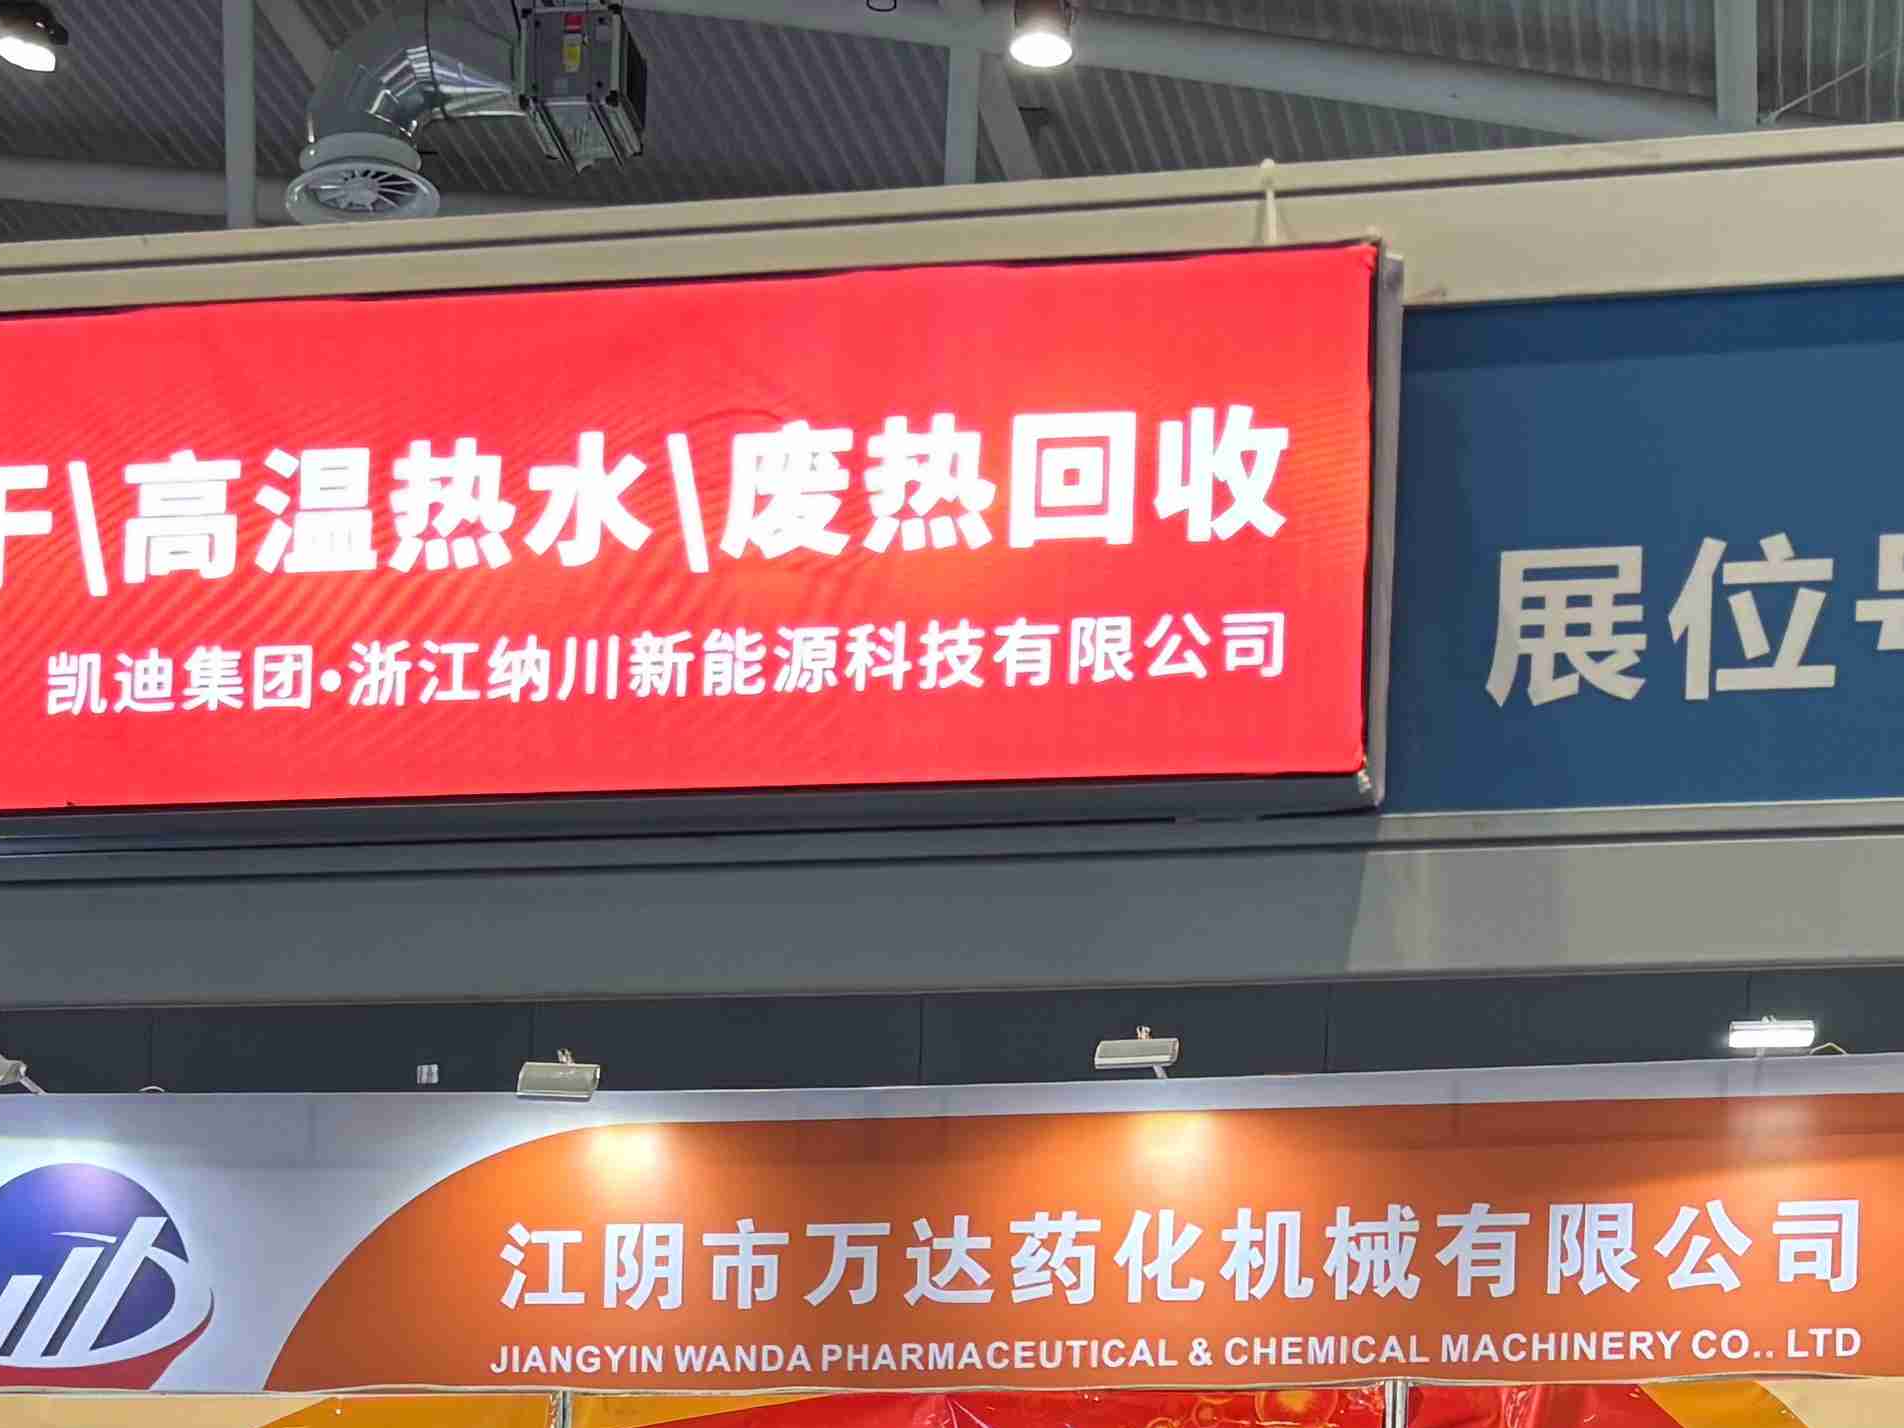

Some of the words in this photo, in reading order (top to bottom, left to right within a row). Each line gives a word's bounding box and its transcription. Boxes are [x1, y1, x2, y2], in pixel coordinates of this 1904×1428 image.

[499, 1199, 1862, 1310] 江阴市万达药化机械有限公司
[490, 1344, 665, 1373] JIANGYIN
[674, 1343, 812, 1373] WANDA
[821, 1336, 1178, 1372] PHARMACEUTICAL
[1188, 1336, 1212, 1366] &
[1224, 1334, 1430, 1365] CHEMICAL
[1440, 1330, 1682, 1362] MACHINERY
[1786, 1327, 1861, 1359] LTD
